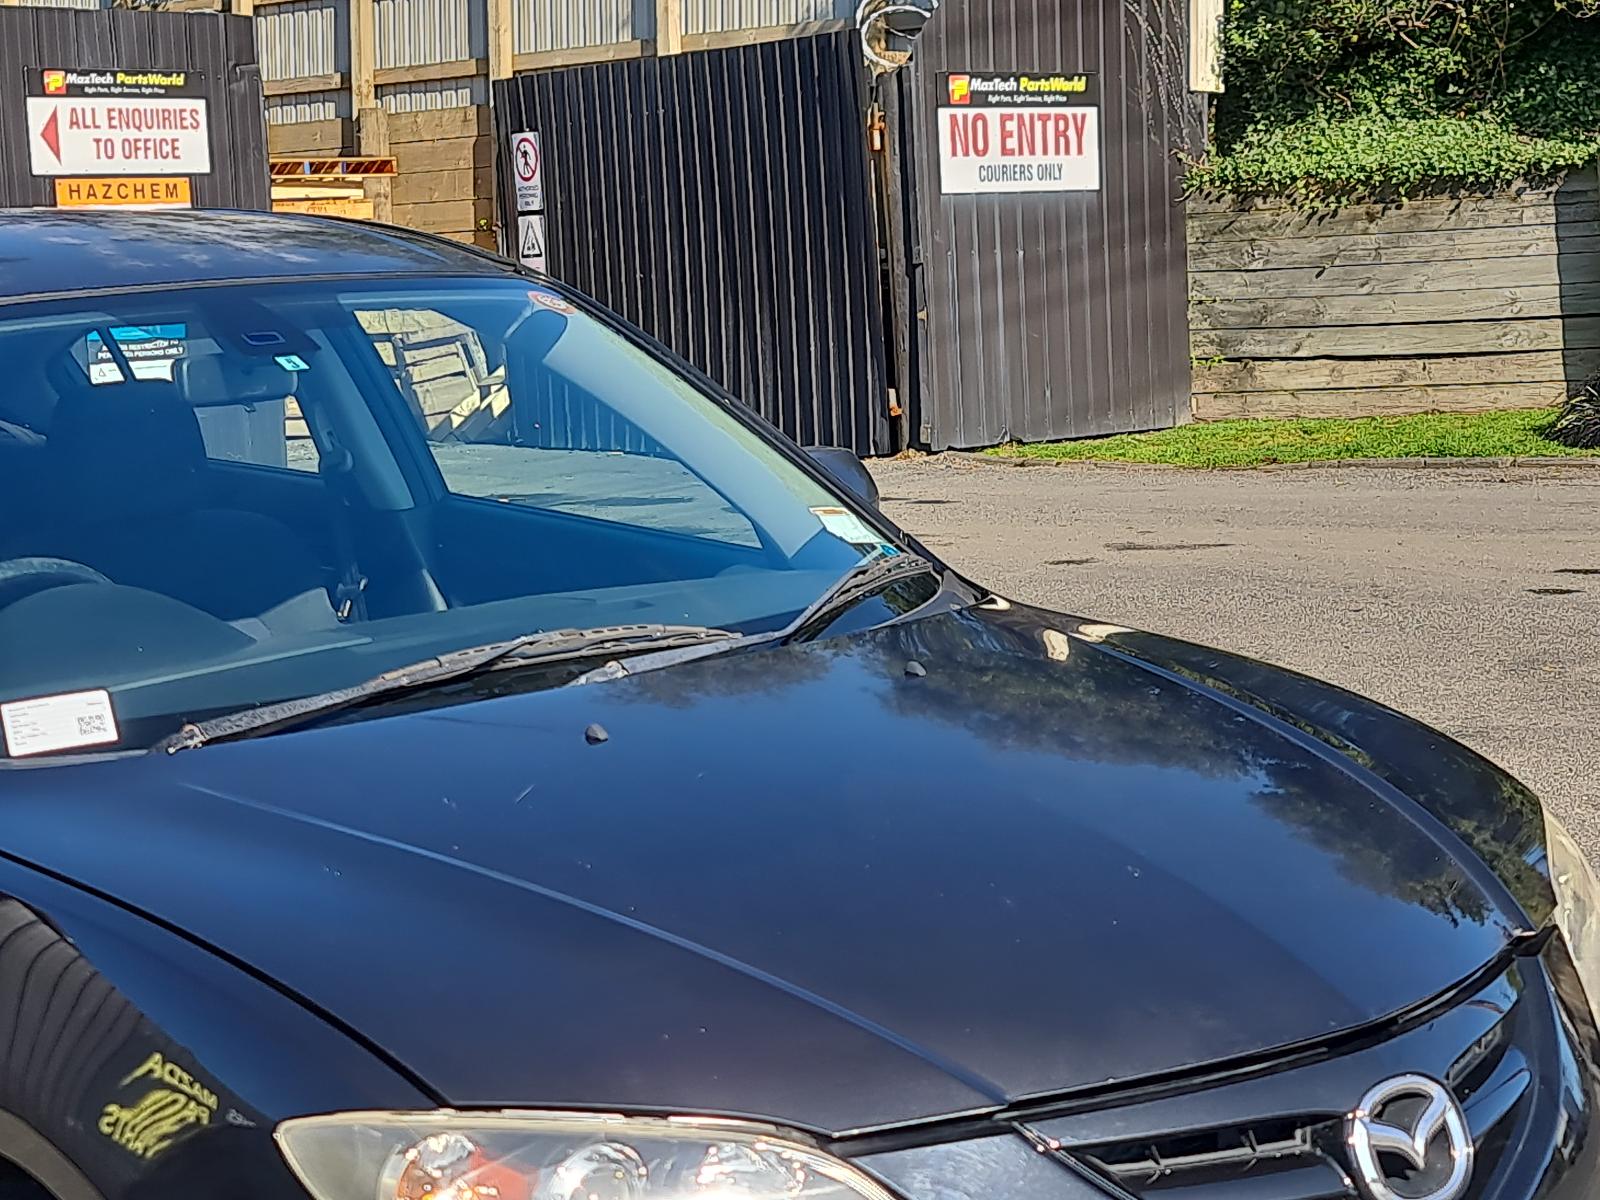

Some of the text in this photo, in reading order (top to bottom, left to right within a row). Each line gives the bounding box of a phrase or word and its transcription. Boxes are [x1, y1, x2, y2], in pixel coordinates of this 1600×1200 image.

[66, 72, 114, 84] MaxTech
[116, 72, 185, 86] PartsWorld
[970, 77, 1017, 91] MaxTech
[1019, 76, 1087, 93] PartsWorld
[69, 107, 200, 131] ALL ENQUIRIES
[949, 113, 1087, 157] NO ENTRY
[93, 138, 181, 160] TO OFFICE
[978, 163, 1063, 182] COURIERS ONLY
[69, 183, 179, 200] HAZCHEM
